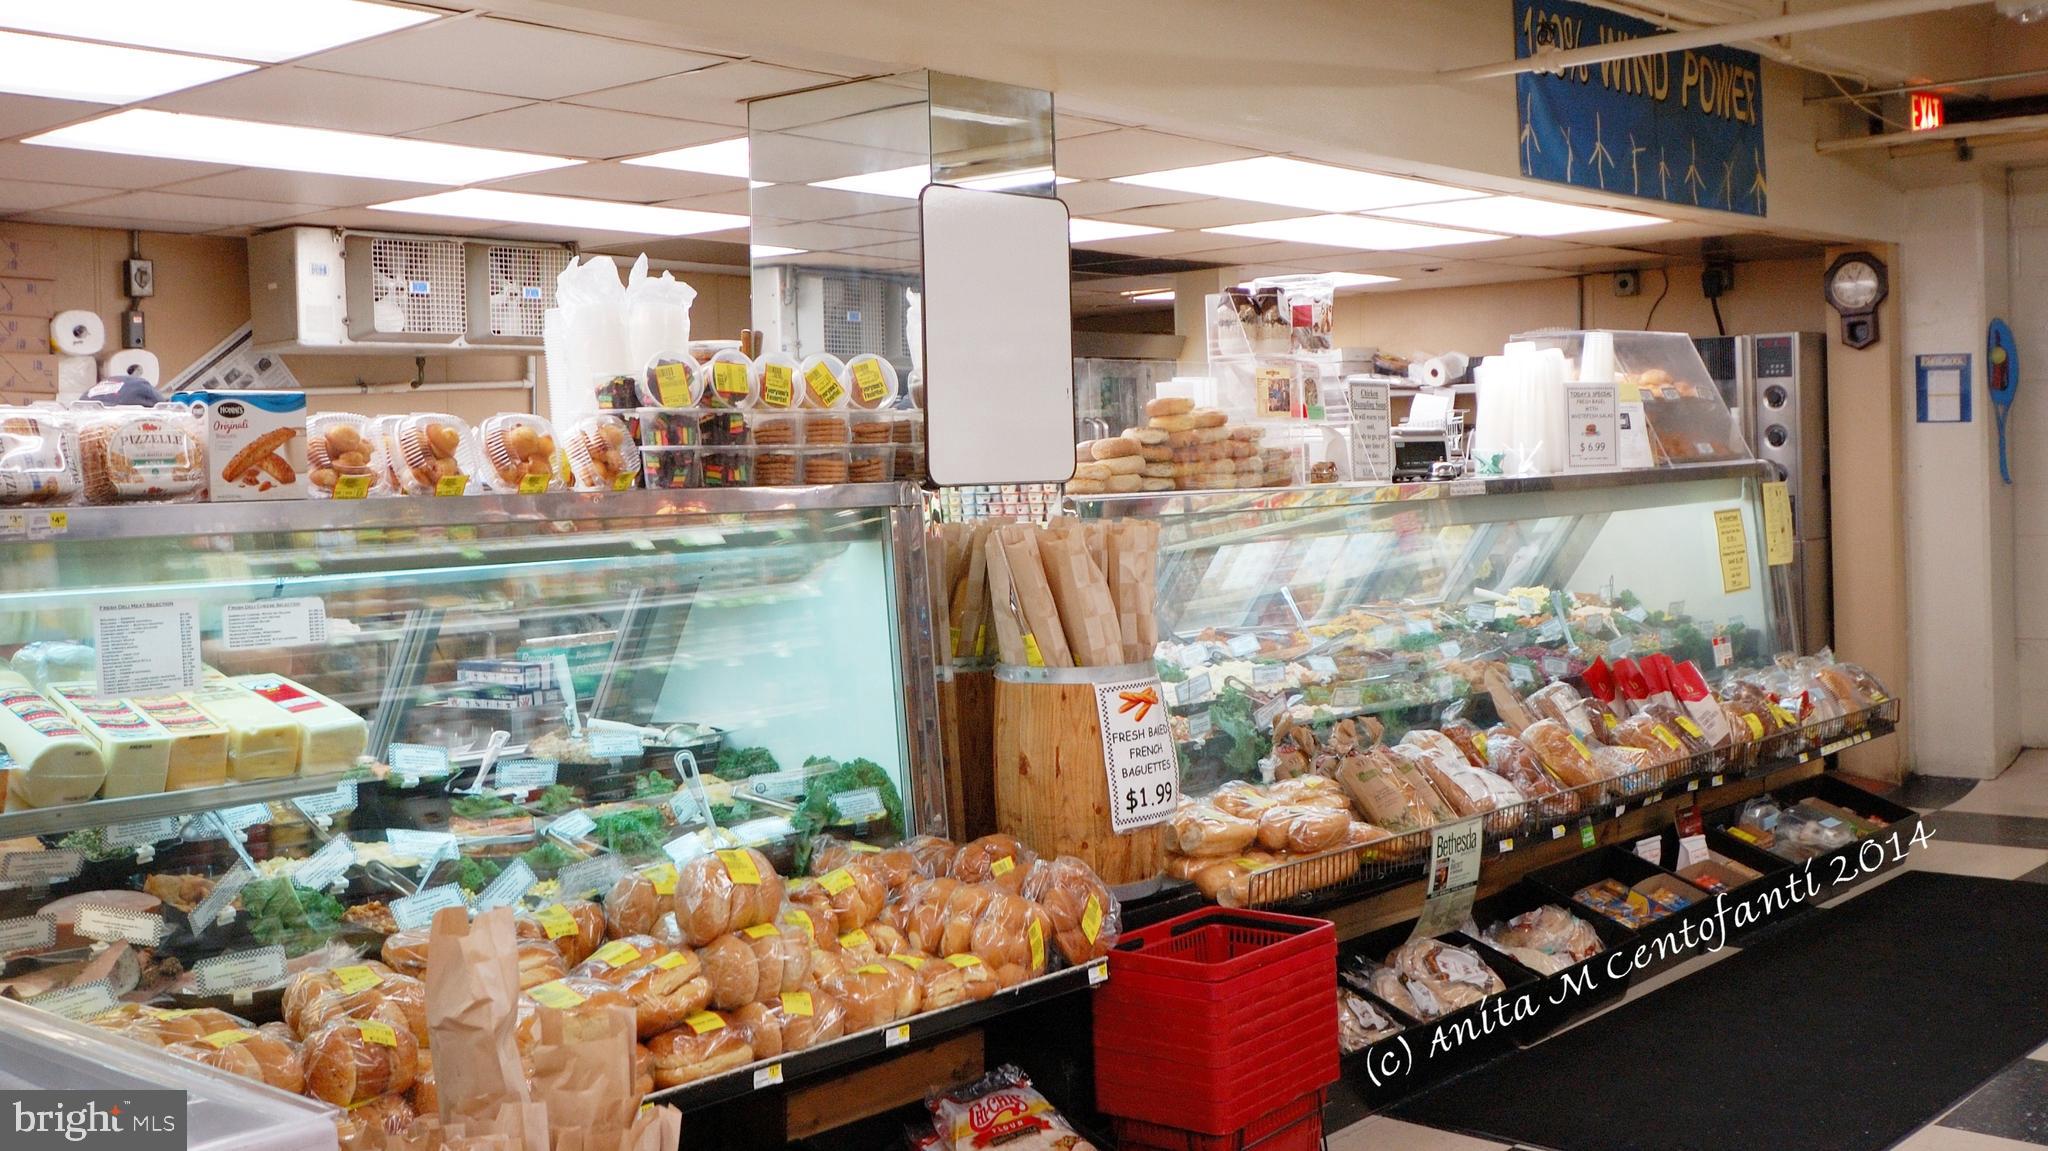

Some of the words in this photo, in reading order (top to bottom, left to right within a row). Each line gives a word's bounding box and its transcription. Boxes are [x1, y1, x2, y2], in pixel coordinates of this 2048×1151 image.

[1600, 24, 1670, 100] WIND
[1682, 50, 1756, 126] POWER
[1911, 95, 1939, 130] EXIT
[120, 433, 184, 447] PIZZELLE
[1588, 442, 1606, 452] 6.99
[1112, 728, 1146, 743] FRESH
[1147, 724, 1168, 738] BAKED
[1129, 745, 1164, 759] FRENCH
[1121, 759, 1172, 779] BAGUETTES
[1125, 781, 1172, 813] $1.99
[1437, 827, 1478, 858] Bethesda
[992, 1119, 1023, 1134] FLOUR
